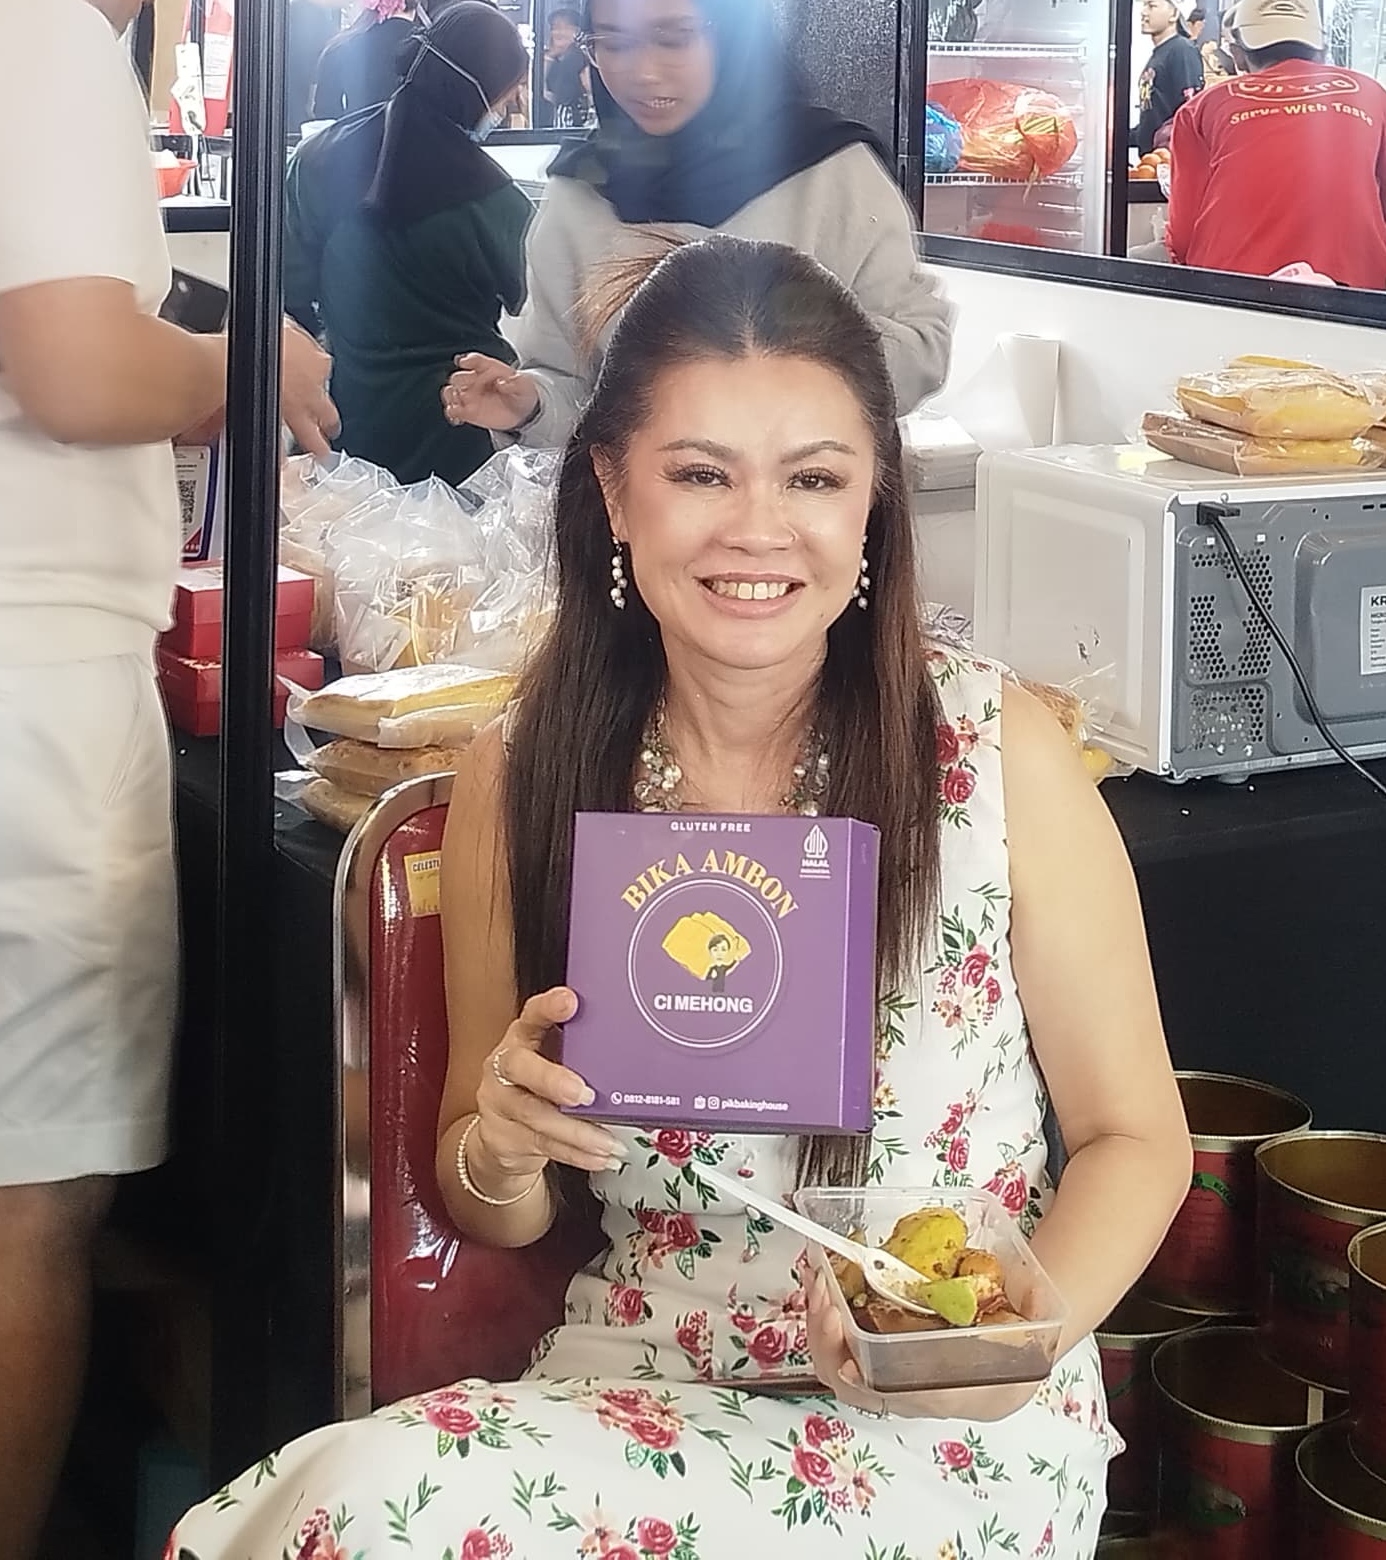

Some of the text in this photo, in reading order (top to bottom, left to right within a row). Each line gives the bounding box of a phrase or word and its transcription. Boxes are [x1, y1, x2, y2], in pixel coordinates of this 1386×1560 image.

[1282, 102, 1328, 118] With
[670, 821, 752, 833] GLUTEN FREE
[620, 848, 800, 920] BIKA AMBON
[654, 995, 753, 1015] CI MEHONG
